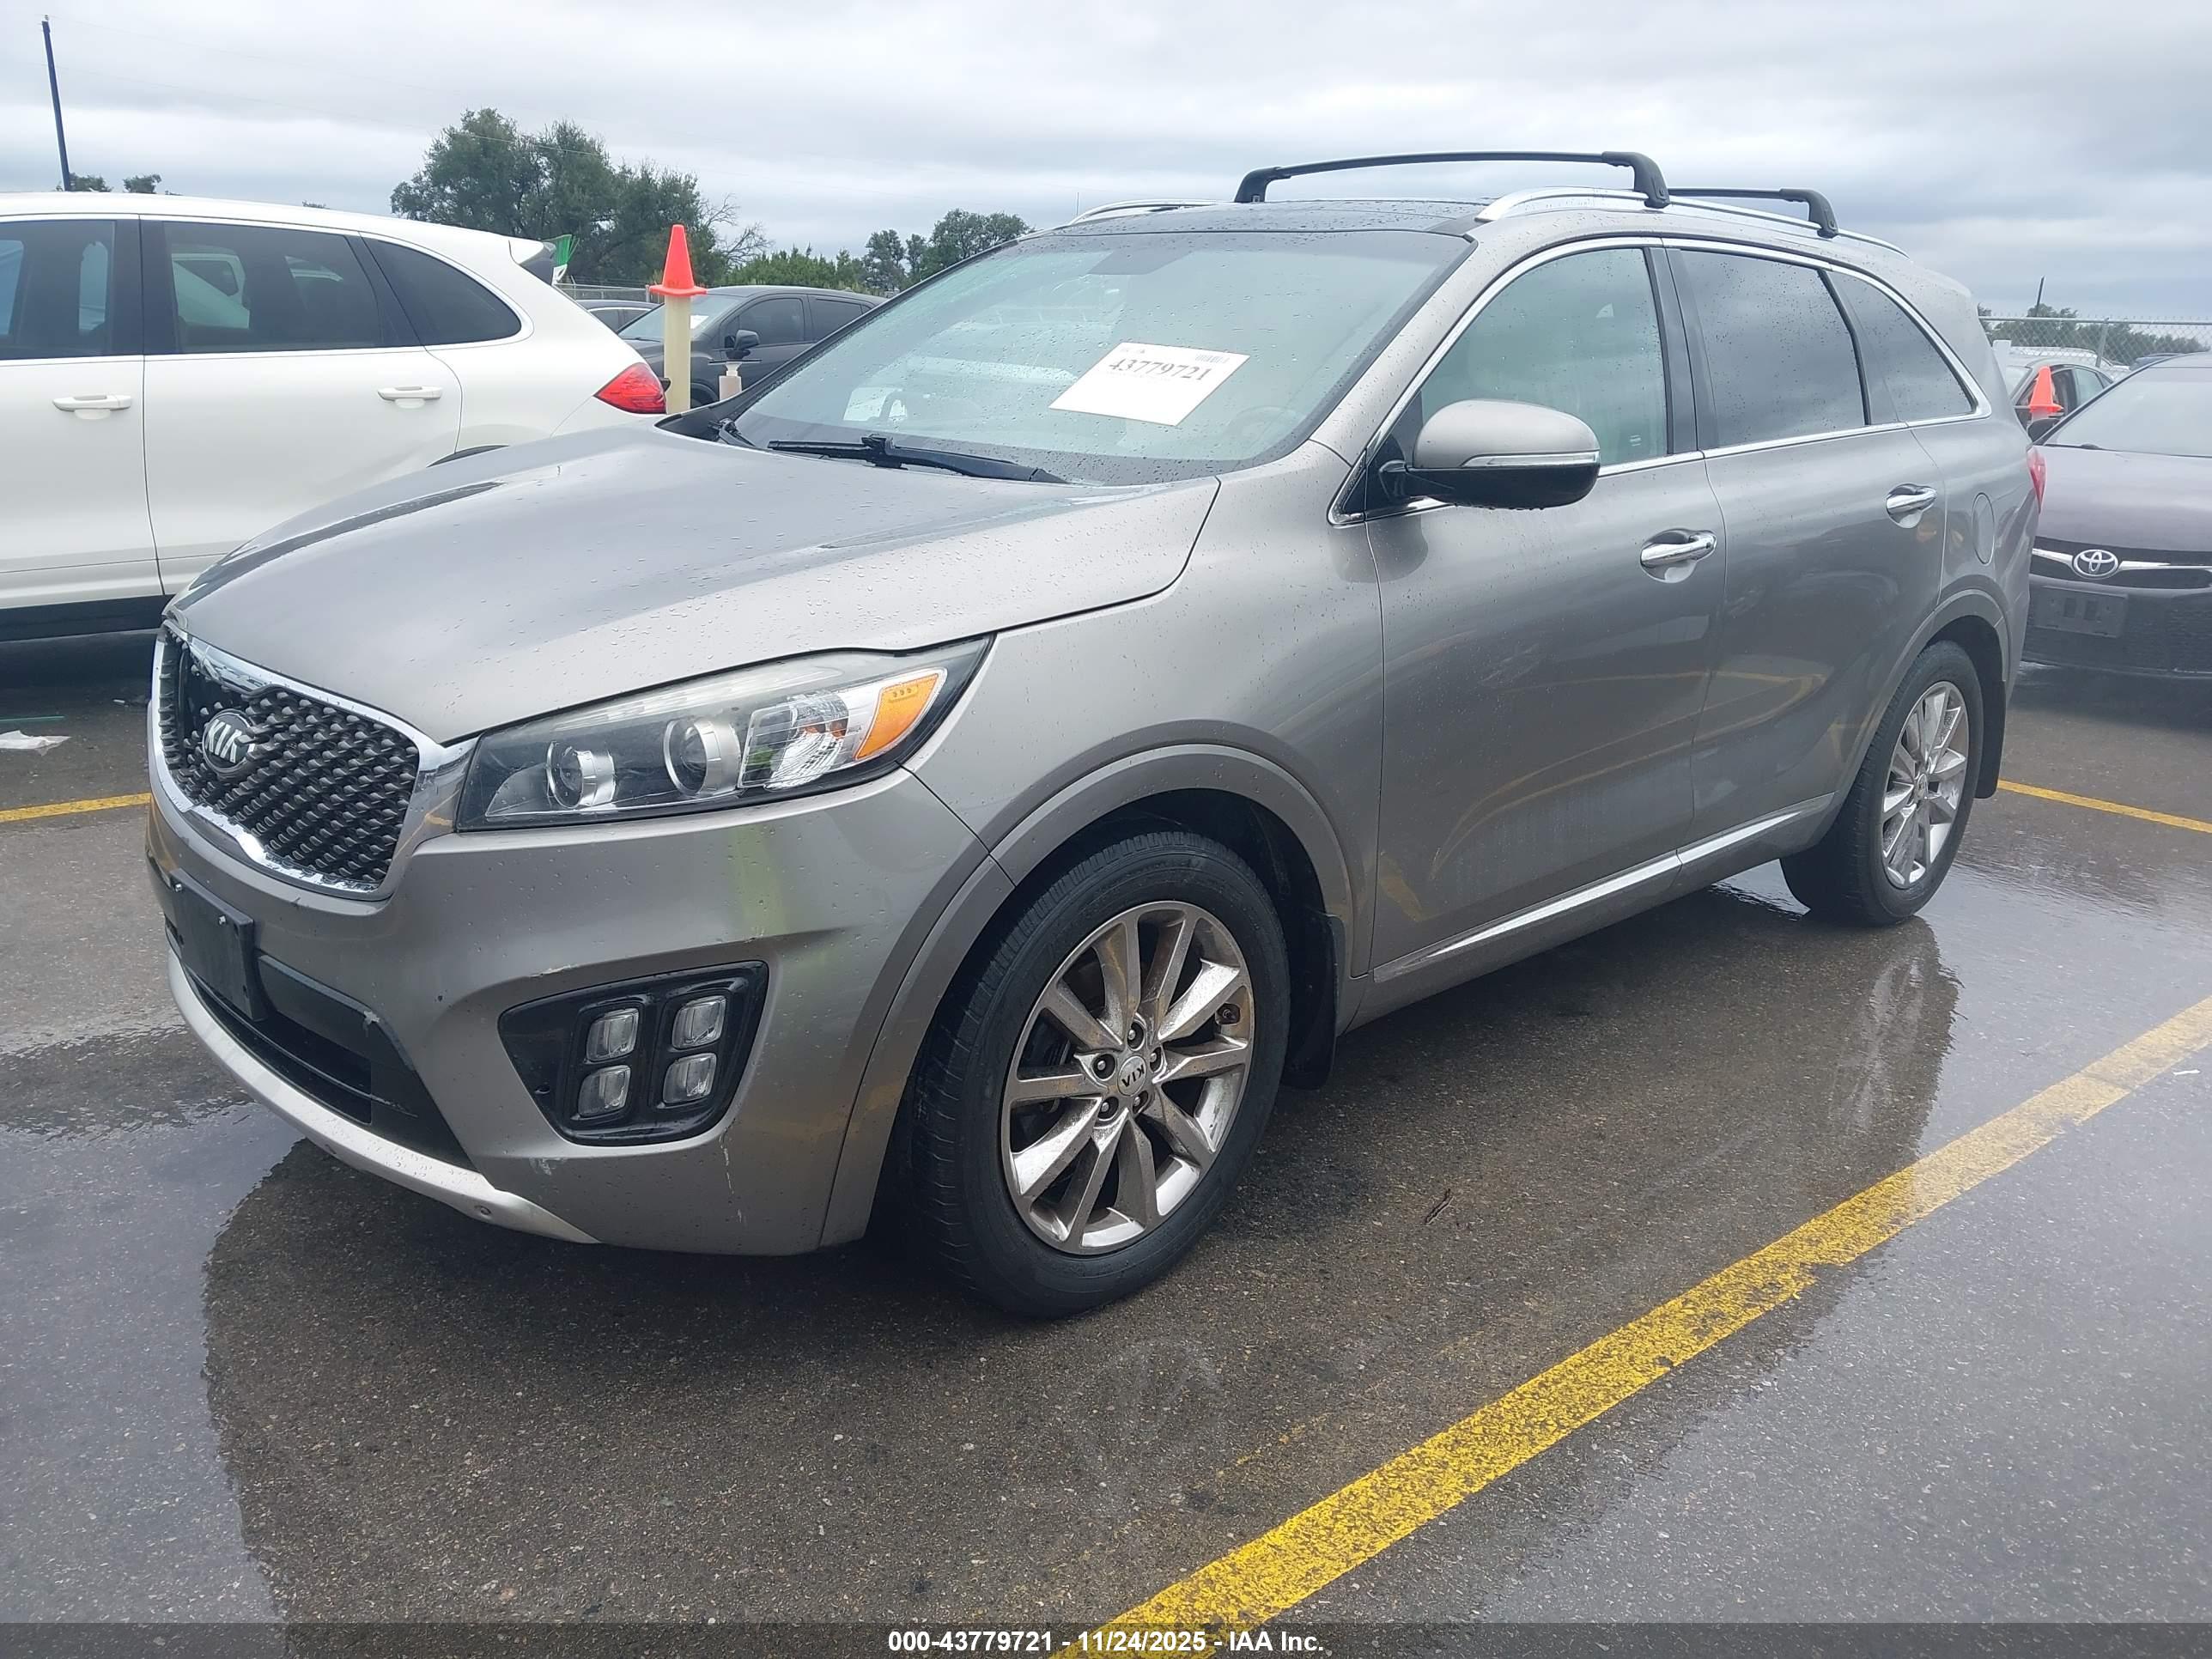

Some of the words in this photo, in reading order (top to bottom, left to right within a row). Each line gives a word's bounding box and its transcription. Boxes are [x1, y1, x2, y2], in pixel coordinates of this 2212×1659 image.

[1109, 358, 1212, 380] 43779721
[205, 719, 242, 763] KIA
[1121, 1064, 1146, 1087] KIA
